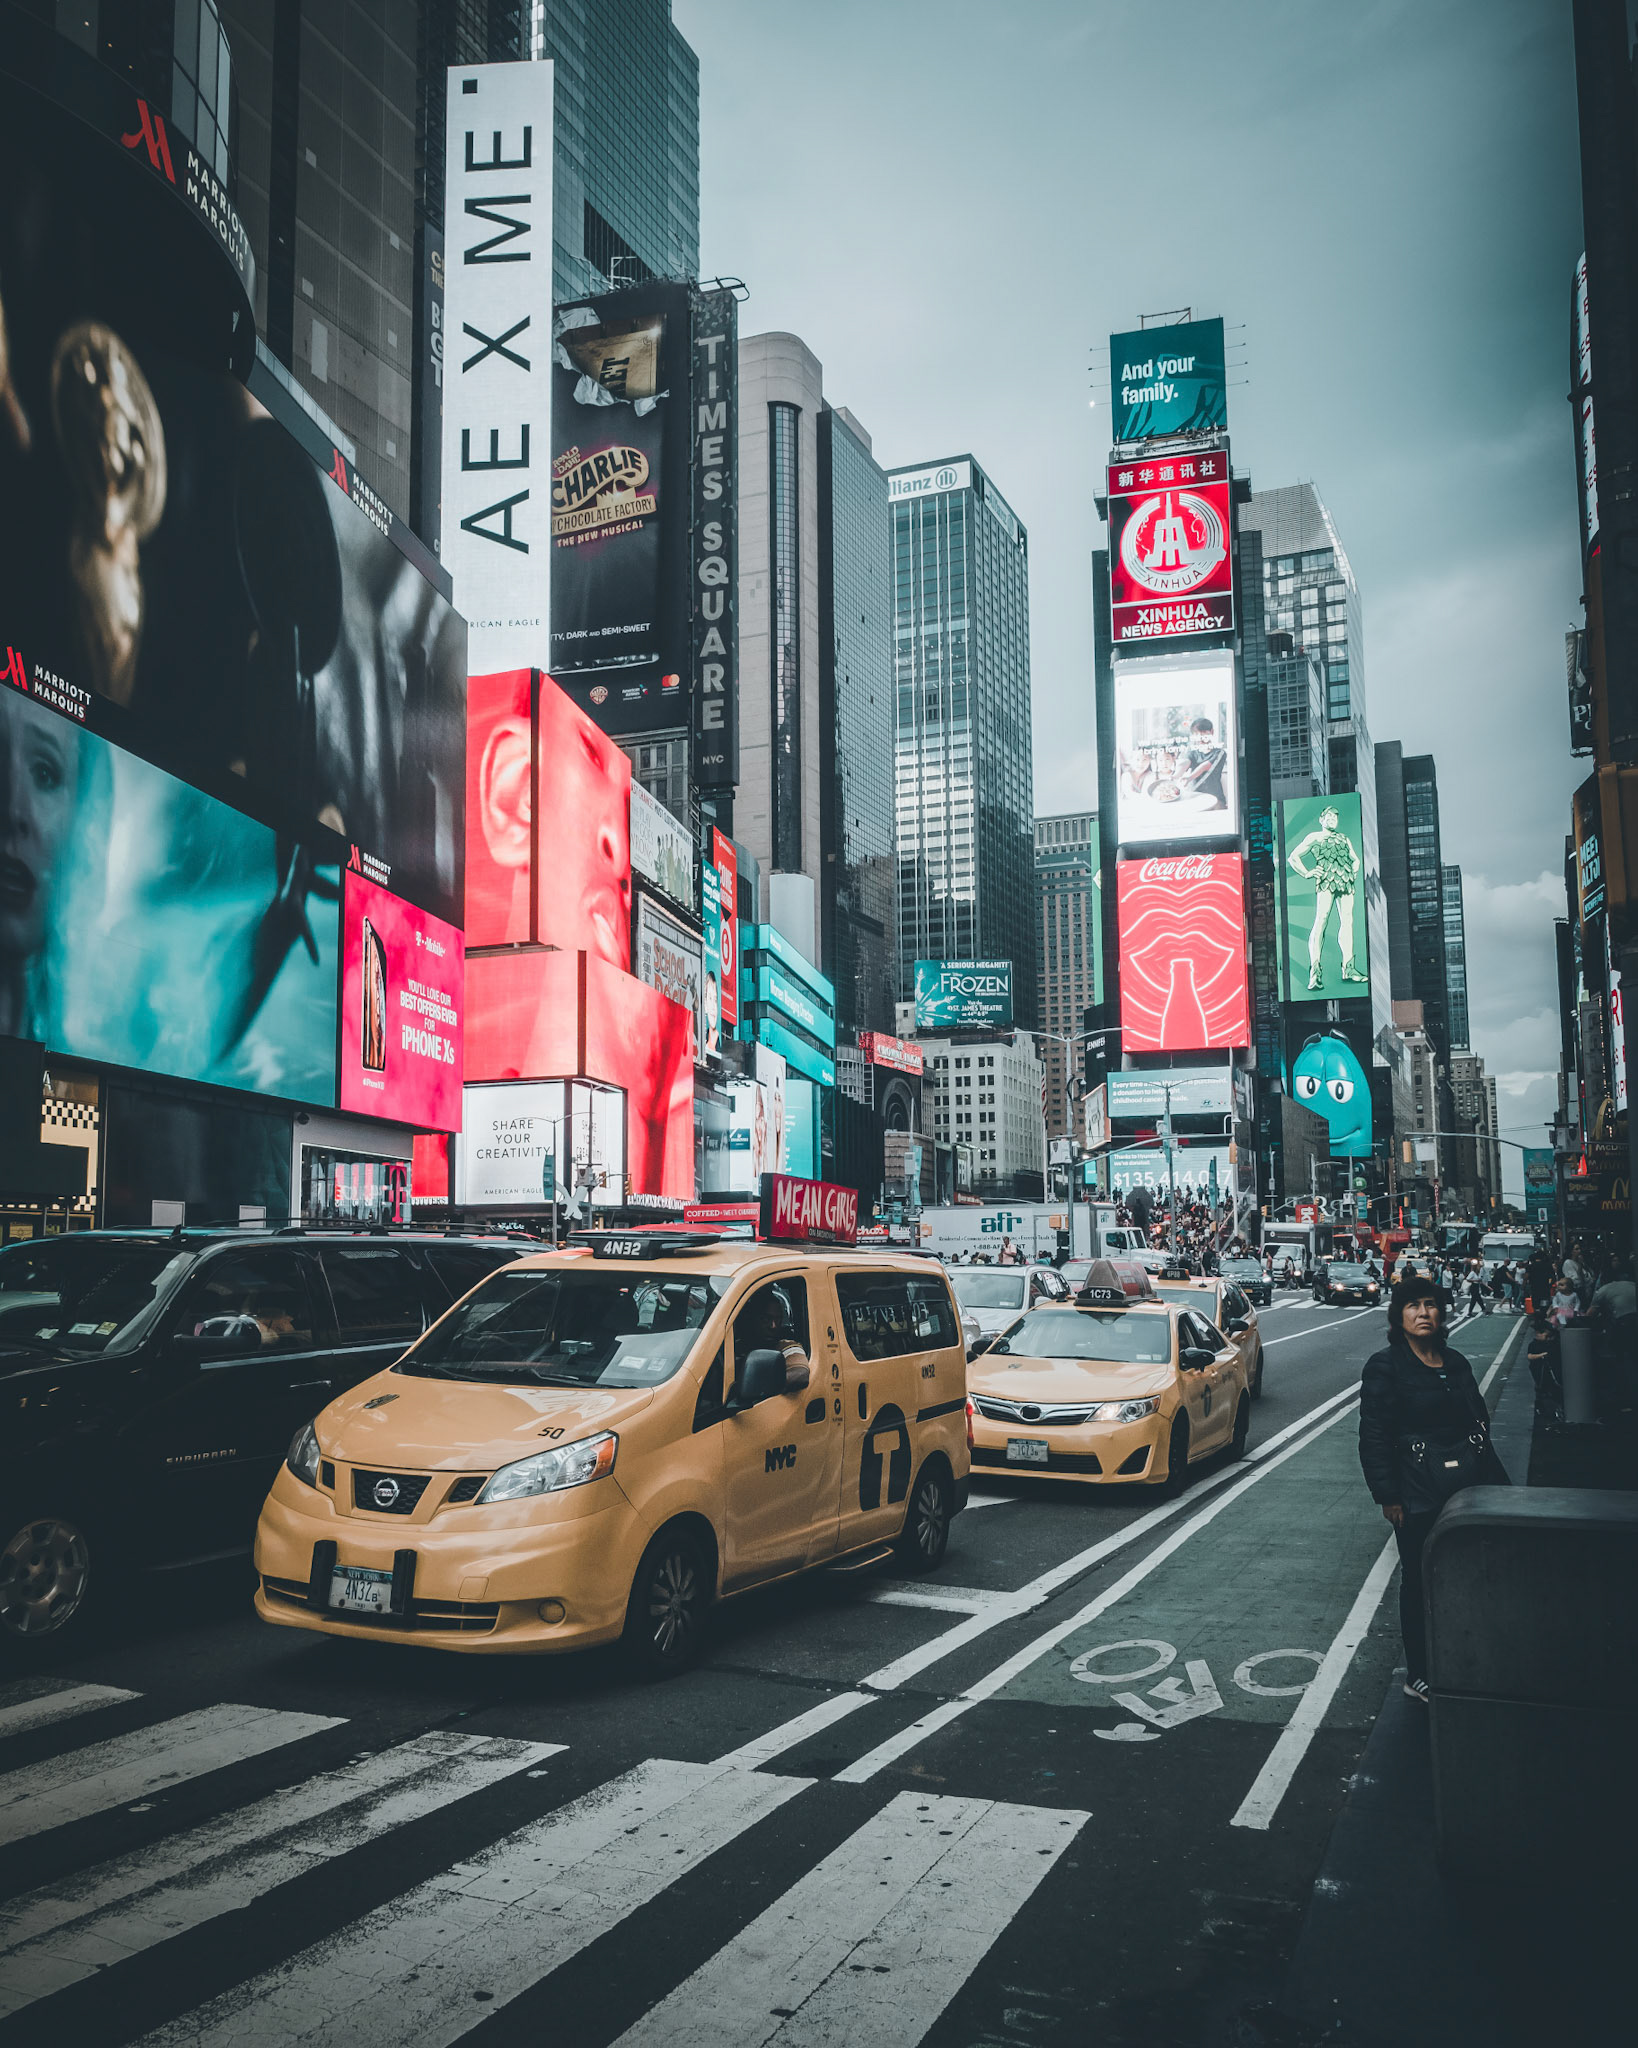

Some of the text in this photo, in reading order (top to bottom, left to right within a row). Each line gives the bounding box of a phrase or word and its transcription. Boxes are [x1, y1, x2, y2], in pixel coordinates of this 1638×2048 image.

[188, 150, 248, 254] MARRIOTT
[187, 177, 243, 271] MARQUIS
[1121, 356, 1195, 381] And your
[1121, 382, 1179, 405] family.
[553, 446, 579, 468] ROALD
[551, 449, 642, 508] CHARLIE
[1118, 460, 1216, 487] 新华通讯社
[352, 472, 393, 524] MARRIOTT
[352, 490, 388, 535] MARQUIS
[557, 507, 612, 531] CHOCOLATE
[615, 498, 653, 518] FACTORY
[557, 520, 643, 547] THE NEW MUSICAL
[698, 334, 729, 730] TIMES SQUARE
[1145, 569, 1203, 589] XINHUA
[509, 618, 540, 627] EAGLE
[1137, 602, 1208, 624] XINHUA
[566, 630, 588, 640] DARK
[601, 622, 651, 637] SEMI-SWEET
[1121, 616, 1224, 638] NEWS AGENCY
[35, 664, 91, 705] MARRIOTT
[34, 682, 84, 718] MARQUIS
[702, 755, 724, 766] NYC
[363, 852, 391, 875] MARRIOTT
[363, 865, 388, 885] MARQUIS
[1139, 854, 1216, 882] Coca-Cola
[654, 937, 688, 985] SCHOOL
[426, 986, 440, 1003] LOVE
[940, 972, 1008, 996] FROZEN
[400, 992, 458, 1028] BEST OFFERS EVER
[424, 1018, 436, 1032] FOR
[402, 1024, 442, 1061] iPHONE
[492, 1119, 534, 1131] SHARE
[495, 1133, 530, 1144] YOUR
[476, 1146, 550, 1159] CREATIVITY
[776, 1180, 856, 1236] MEAN GIRLS
[809, 1227, 836, 1240] ON BROADWAY
[981, 1212, 1022, 1232] afr
[603, 1241, 641, 1256] 4N32
[1090, 1289, 1111, 1299] 1C73
[537, 1427, 566, 1439] 50
[166, 1448, 236, 1463] SUBURBAN
[765, 1444, 797, 1472] NYC
[349, 1570, 379, 1582] NEW YORK
